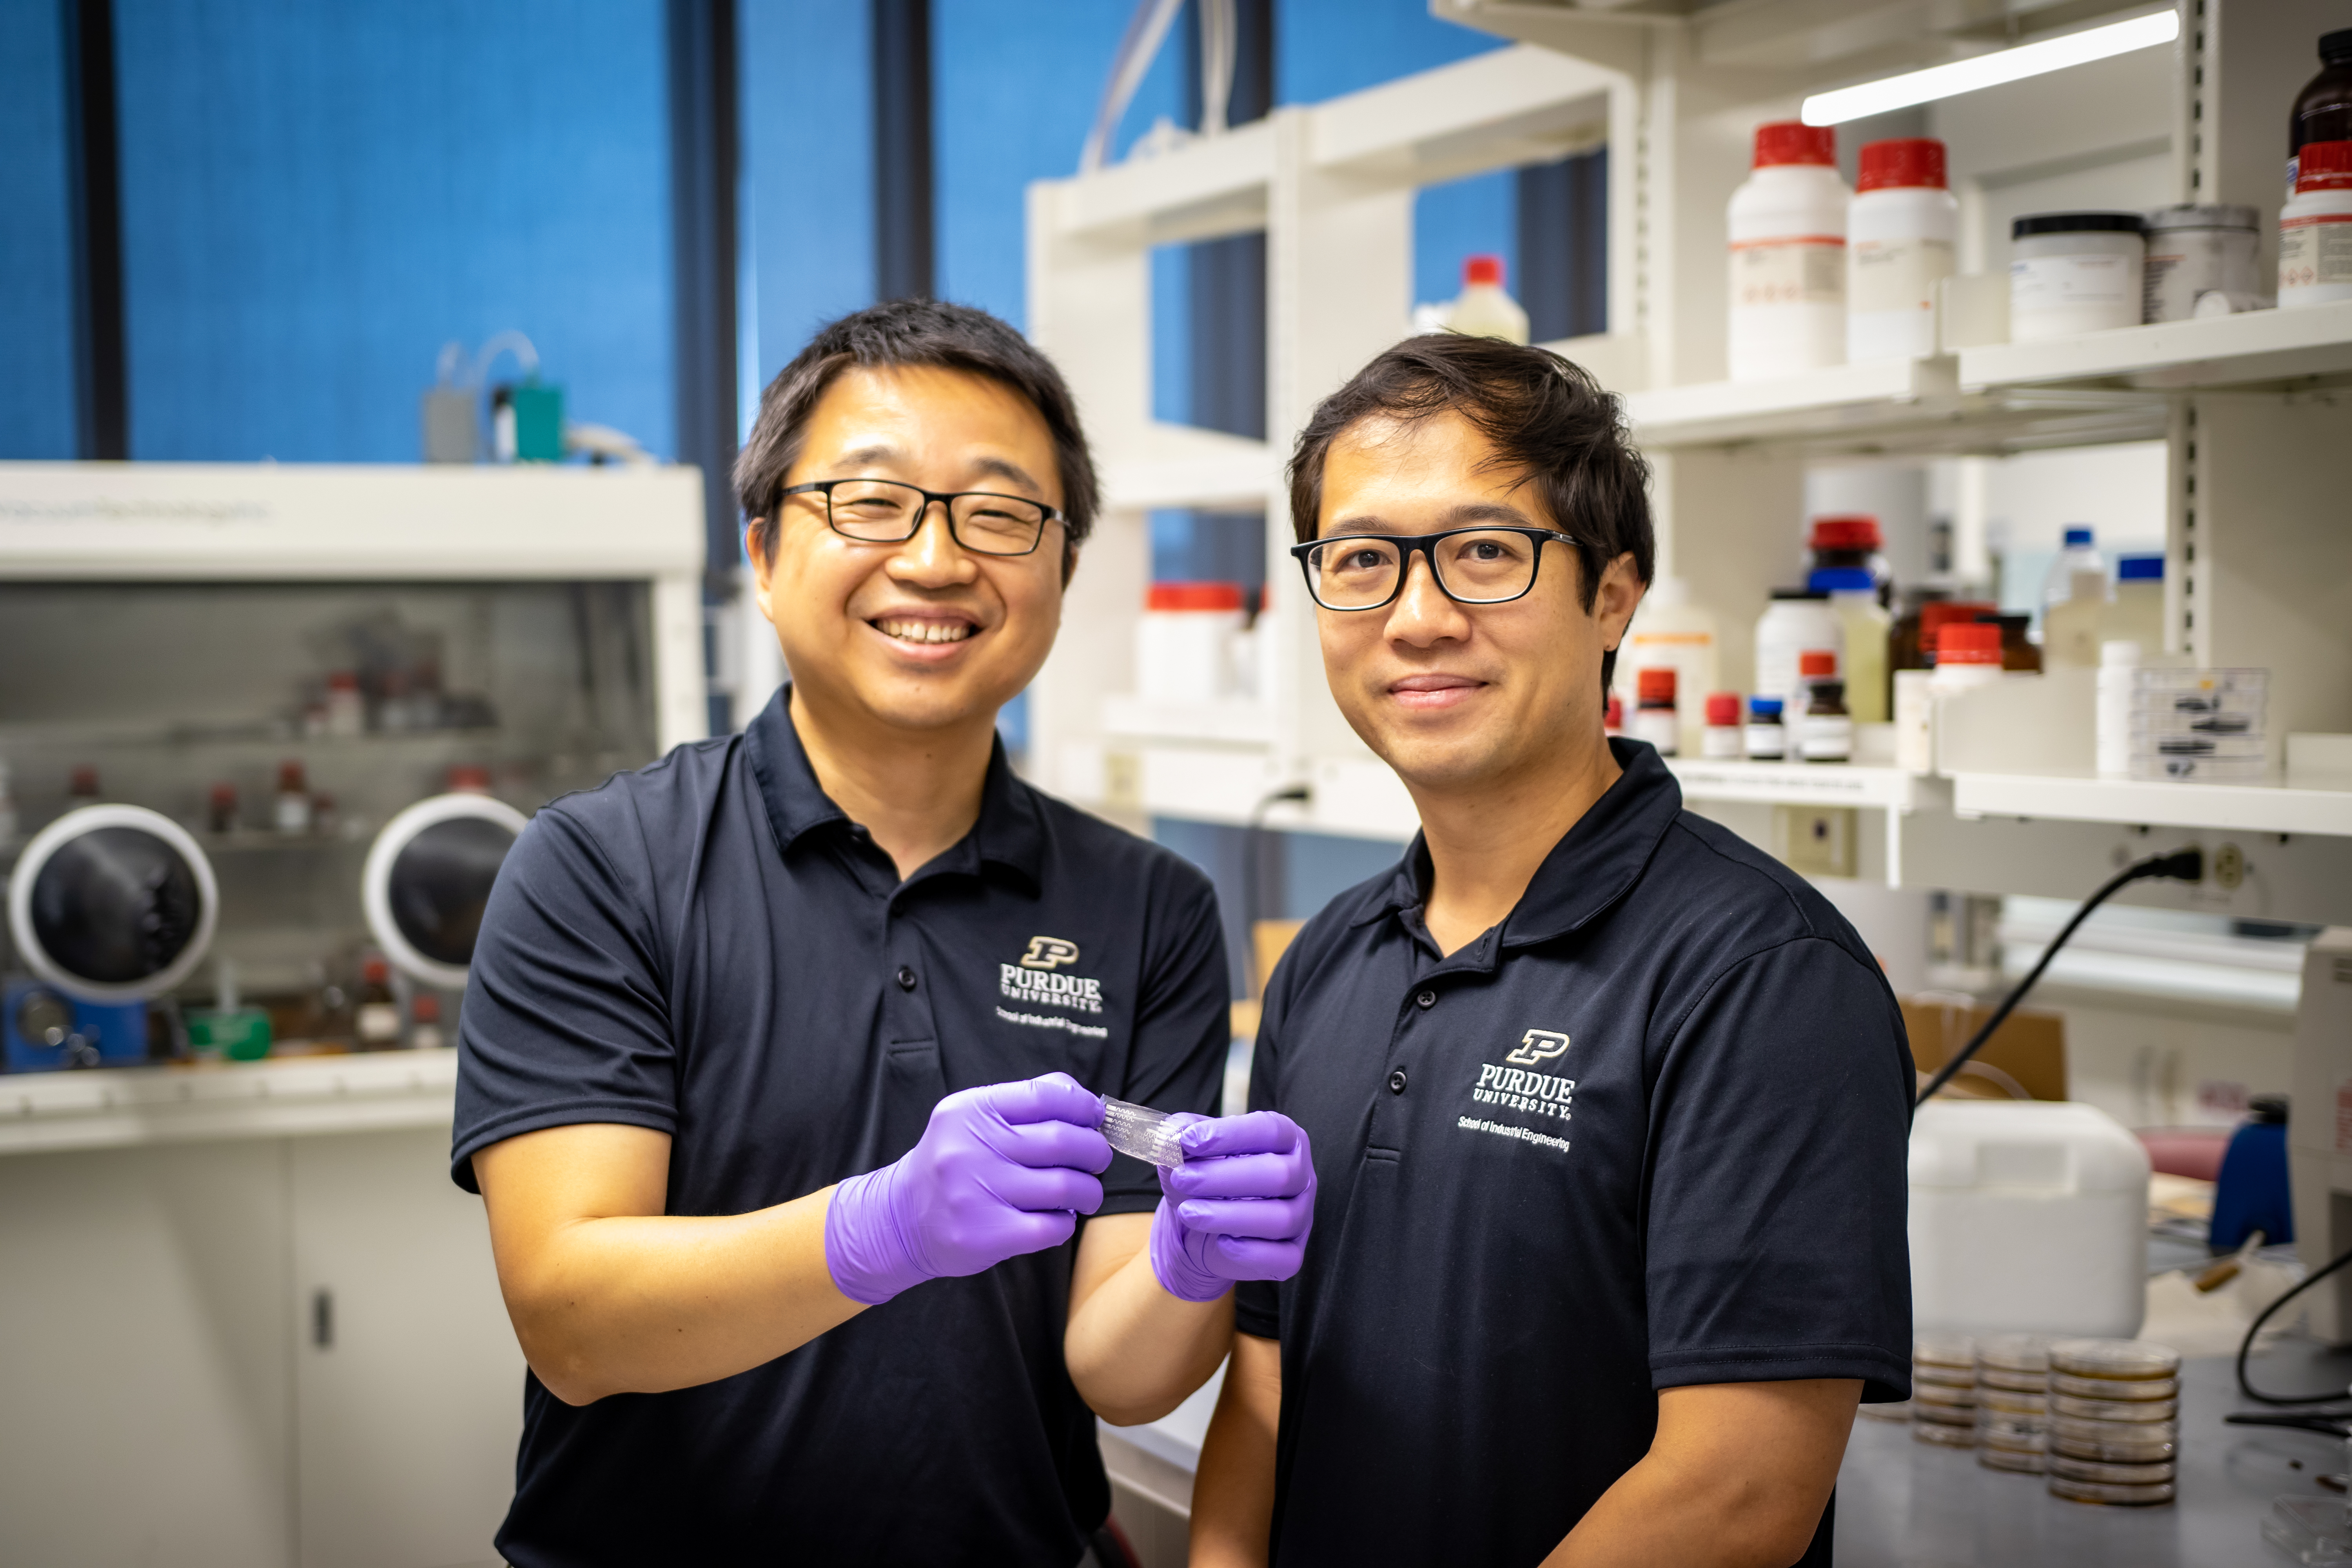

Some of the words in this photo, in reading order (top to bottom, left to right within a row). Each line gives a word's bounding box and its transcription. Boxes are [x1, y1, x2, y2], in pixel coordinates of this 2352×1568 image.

[1020, 936, 1079, 969] P
[1000, 963, 1102, 1000] PURDUE
[1506, 1029, 1570, 1065] P
[1476, 1063, 1575, 1104] PURDUE
[1458, 1116, 1481, 1129] School
[1481, 1121, 1490, 1131] of
[1489, 1121, 1523, 1138] Industrial
[1521, 1128, 1570, 1152] Engineering
